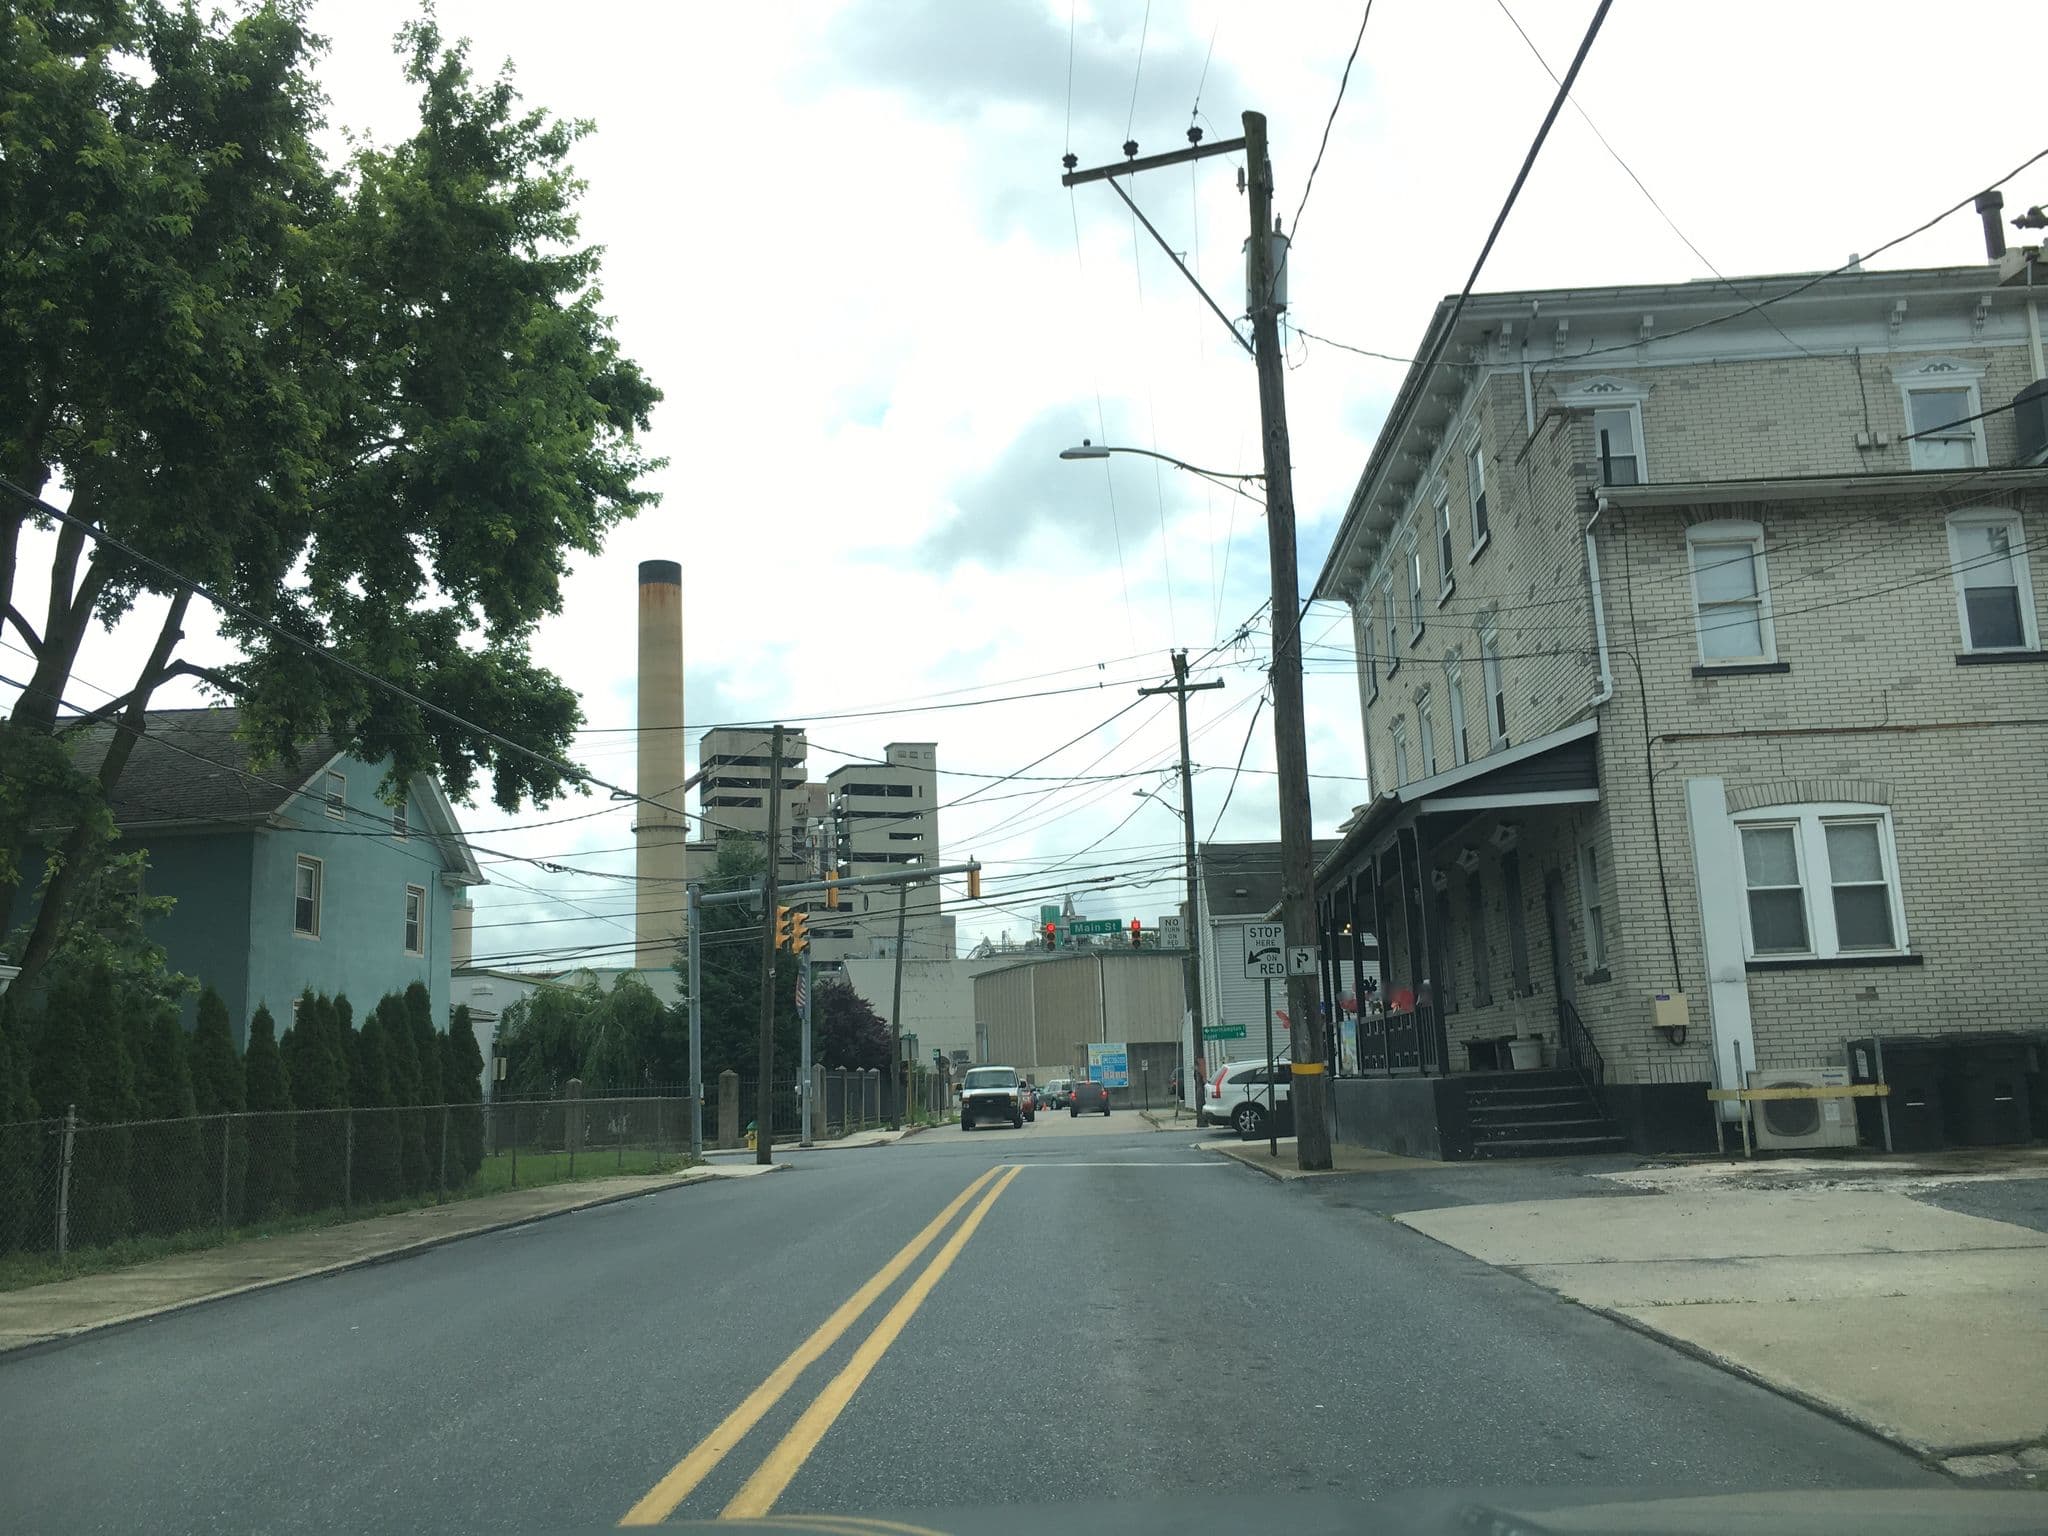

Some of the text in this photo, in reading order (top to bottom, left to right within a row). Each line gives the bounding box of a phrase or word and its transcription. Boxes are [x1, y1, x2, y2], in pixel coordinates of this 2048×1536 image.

[1165, 918, 1179, 926] NO
[1074, 922, 1117, 933] Main St
[1249, 927, 1282, 938] STOP
[1255, 939, 1276, 947] HERE
[1266, 954, 1277, 962] ON
[1260, 963, 1284, 975] RED
